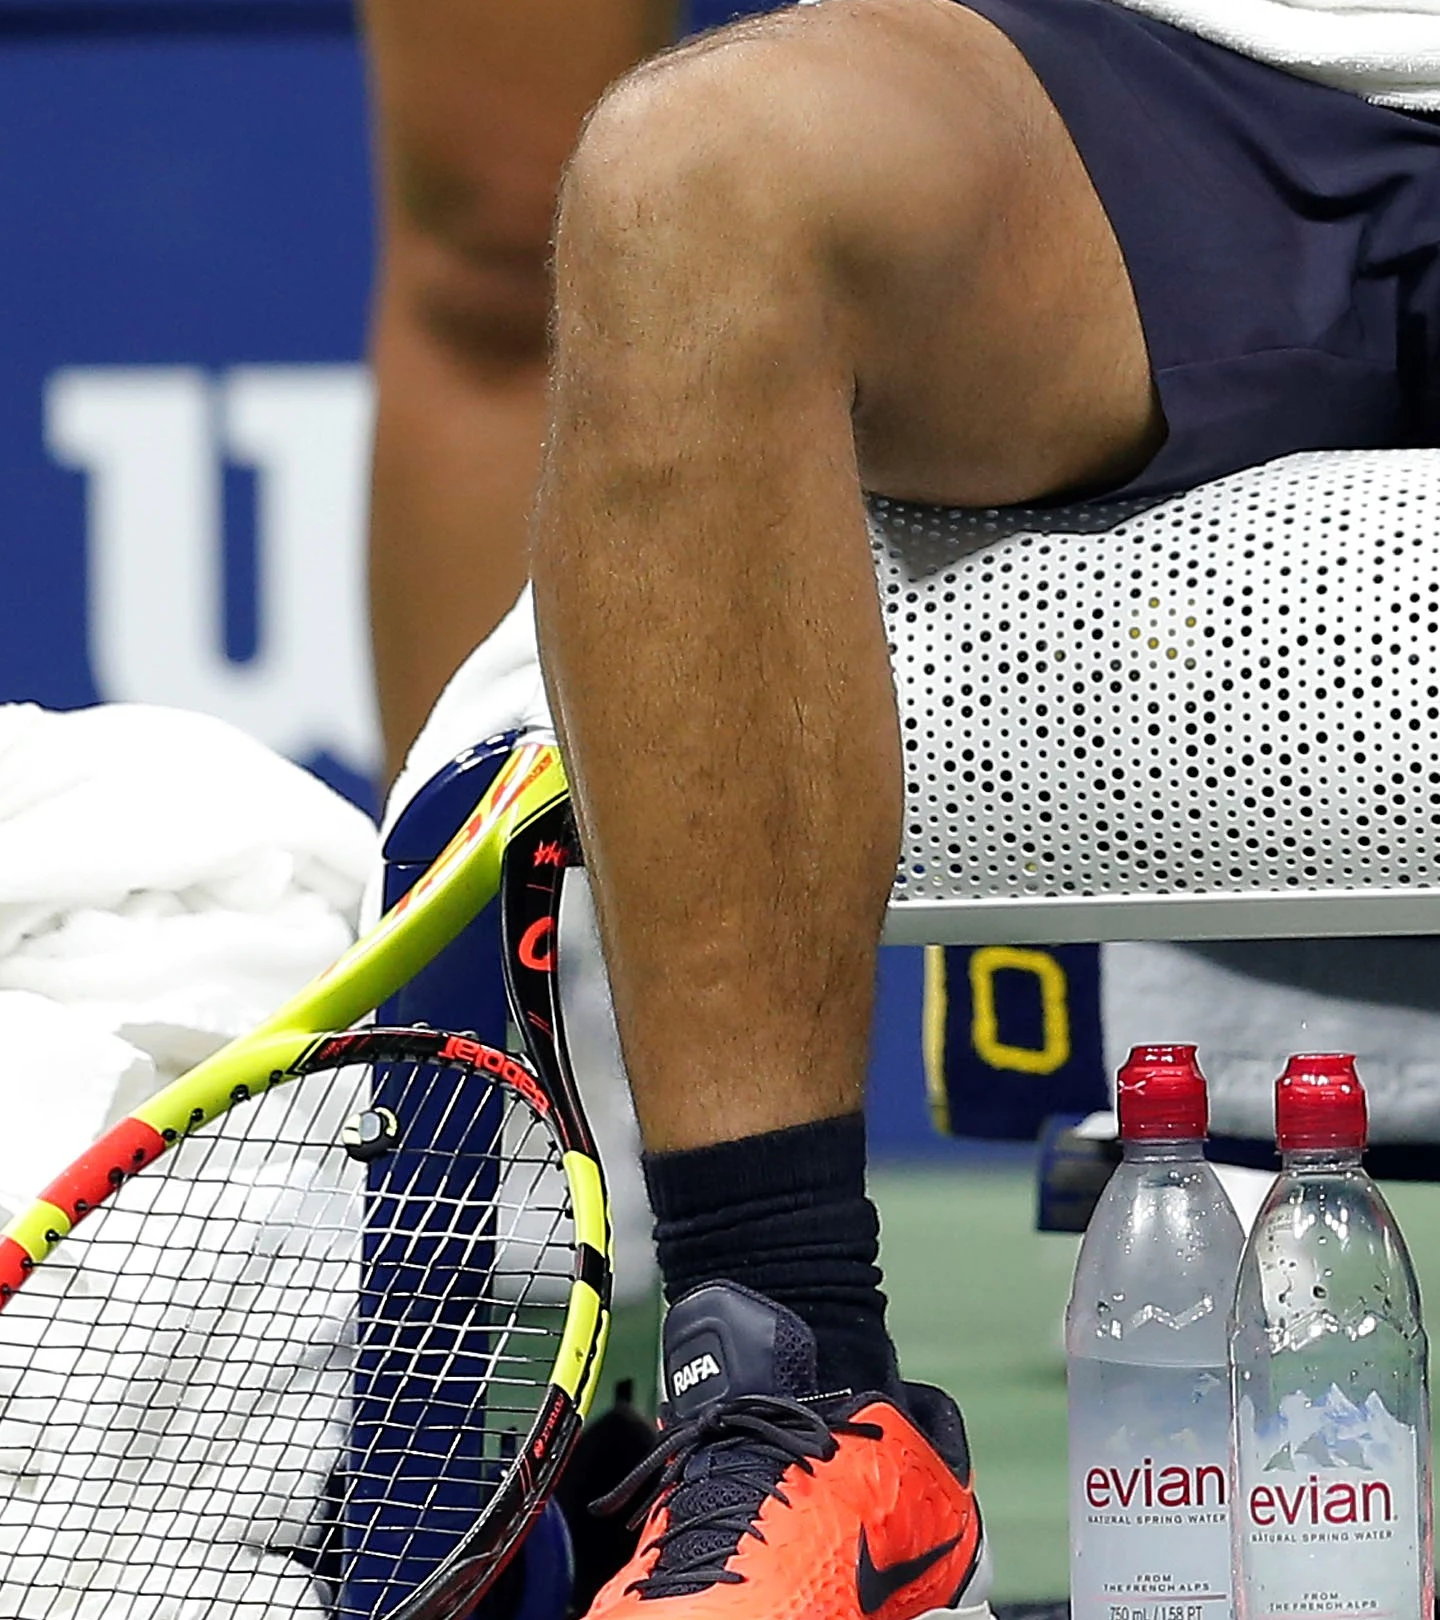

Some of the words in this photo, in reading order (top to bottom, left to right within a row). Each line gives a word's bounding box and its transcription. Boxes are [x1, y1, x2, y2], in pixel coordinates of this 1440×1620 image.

[672, 1353, 720, 1397] RAFA
[1085, 1457, 1226, 1509] evian
[1249, 1475, 1393, 1526] evian
[1088, 1514, 1131, 1525] NATURAL
[1136, 1514, 1182, 1525] SPRING
[1188, 1513, 1227, 1524] WATER
[1251, 1532, 1297, 1543] NATURAL
[1302, 1531, 1349, 1543] SPRING
[1354, 1530, 1393, 1541] WATER
[1136, 1574, 1172, 1583] FROM
[1104, 1584, 1123, 1592] THE
[1126, 1583, 1176, 1592] FRENCH
[1180, 1582, 1210, 1592] ALPS
[1303, 1592, 1339, 1601] FROM
[1269, 1603, 1289, 1612] THE
[1293, 1602, 1343, 1612] FRENCH
[1347, 1600, 1377, 1610] ALPS
[1110, 1606, 1130, 1620] 750
[1188, 1605, 1203, 1620] PT
